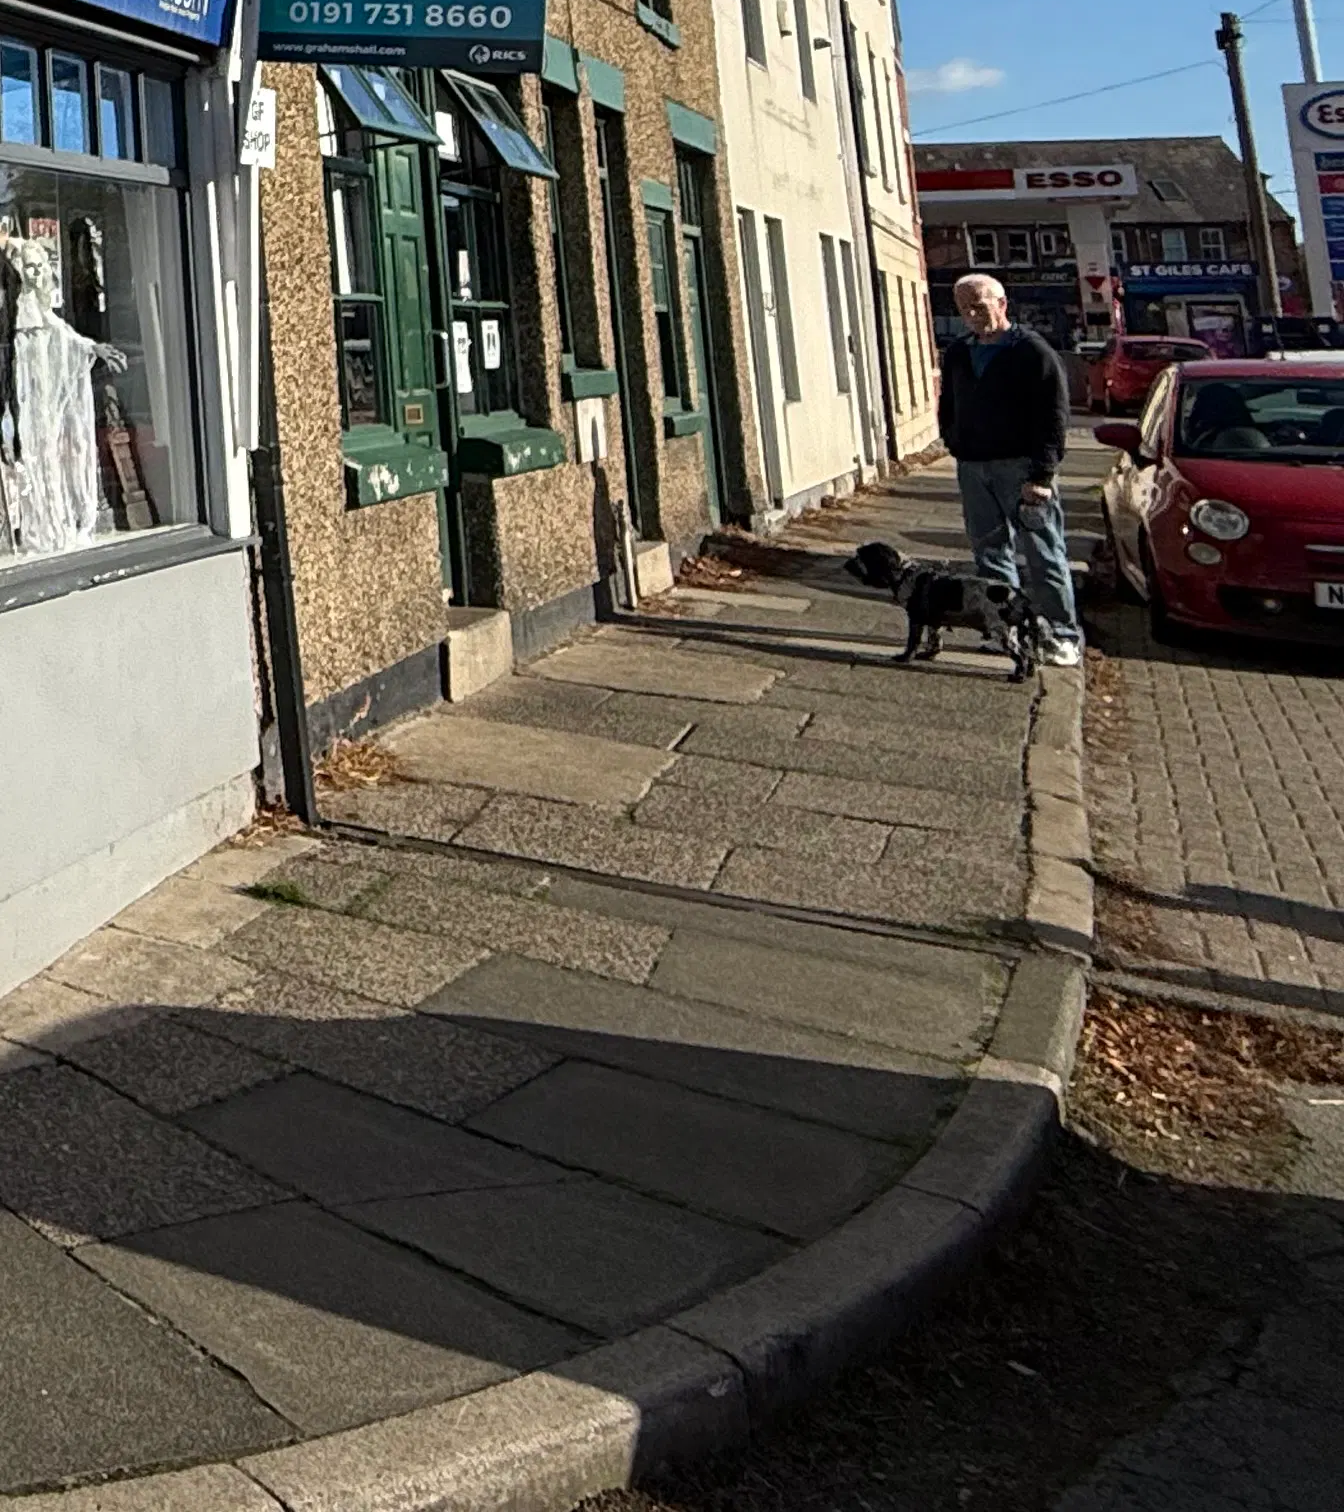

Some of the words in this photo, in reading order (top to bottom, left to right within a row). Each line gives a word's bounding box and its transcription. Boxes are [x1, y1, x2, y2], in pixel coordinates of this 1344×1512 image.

[289, 2, 353, 24] 0191
[364, 3, 413, 26] 731
[425, 5, 512, 29] 8660
[492, 50, 526, 61] RICS
[1026, 170, 1123, 189] ESSO
[1130, 264, 1150, 277] ST
[1155, 264, 1203, 276] GILES
